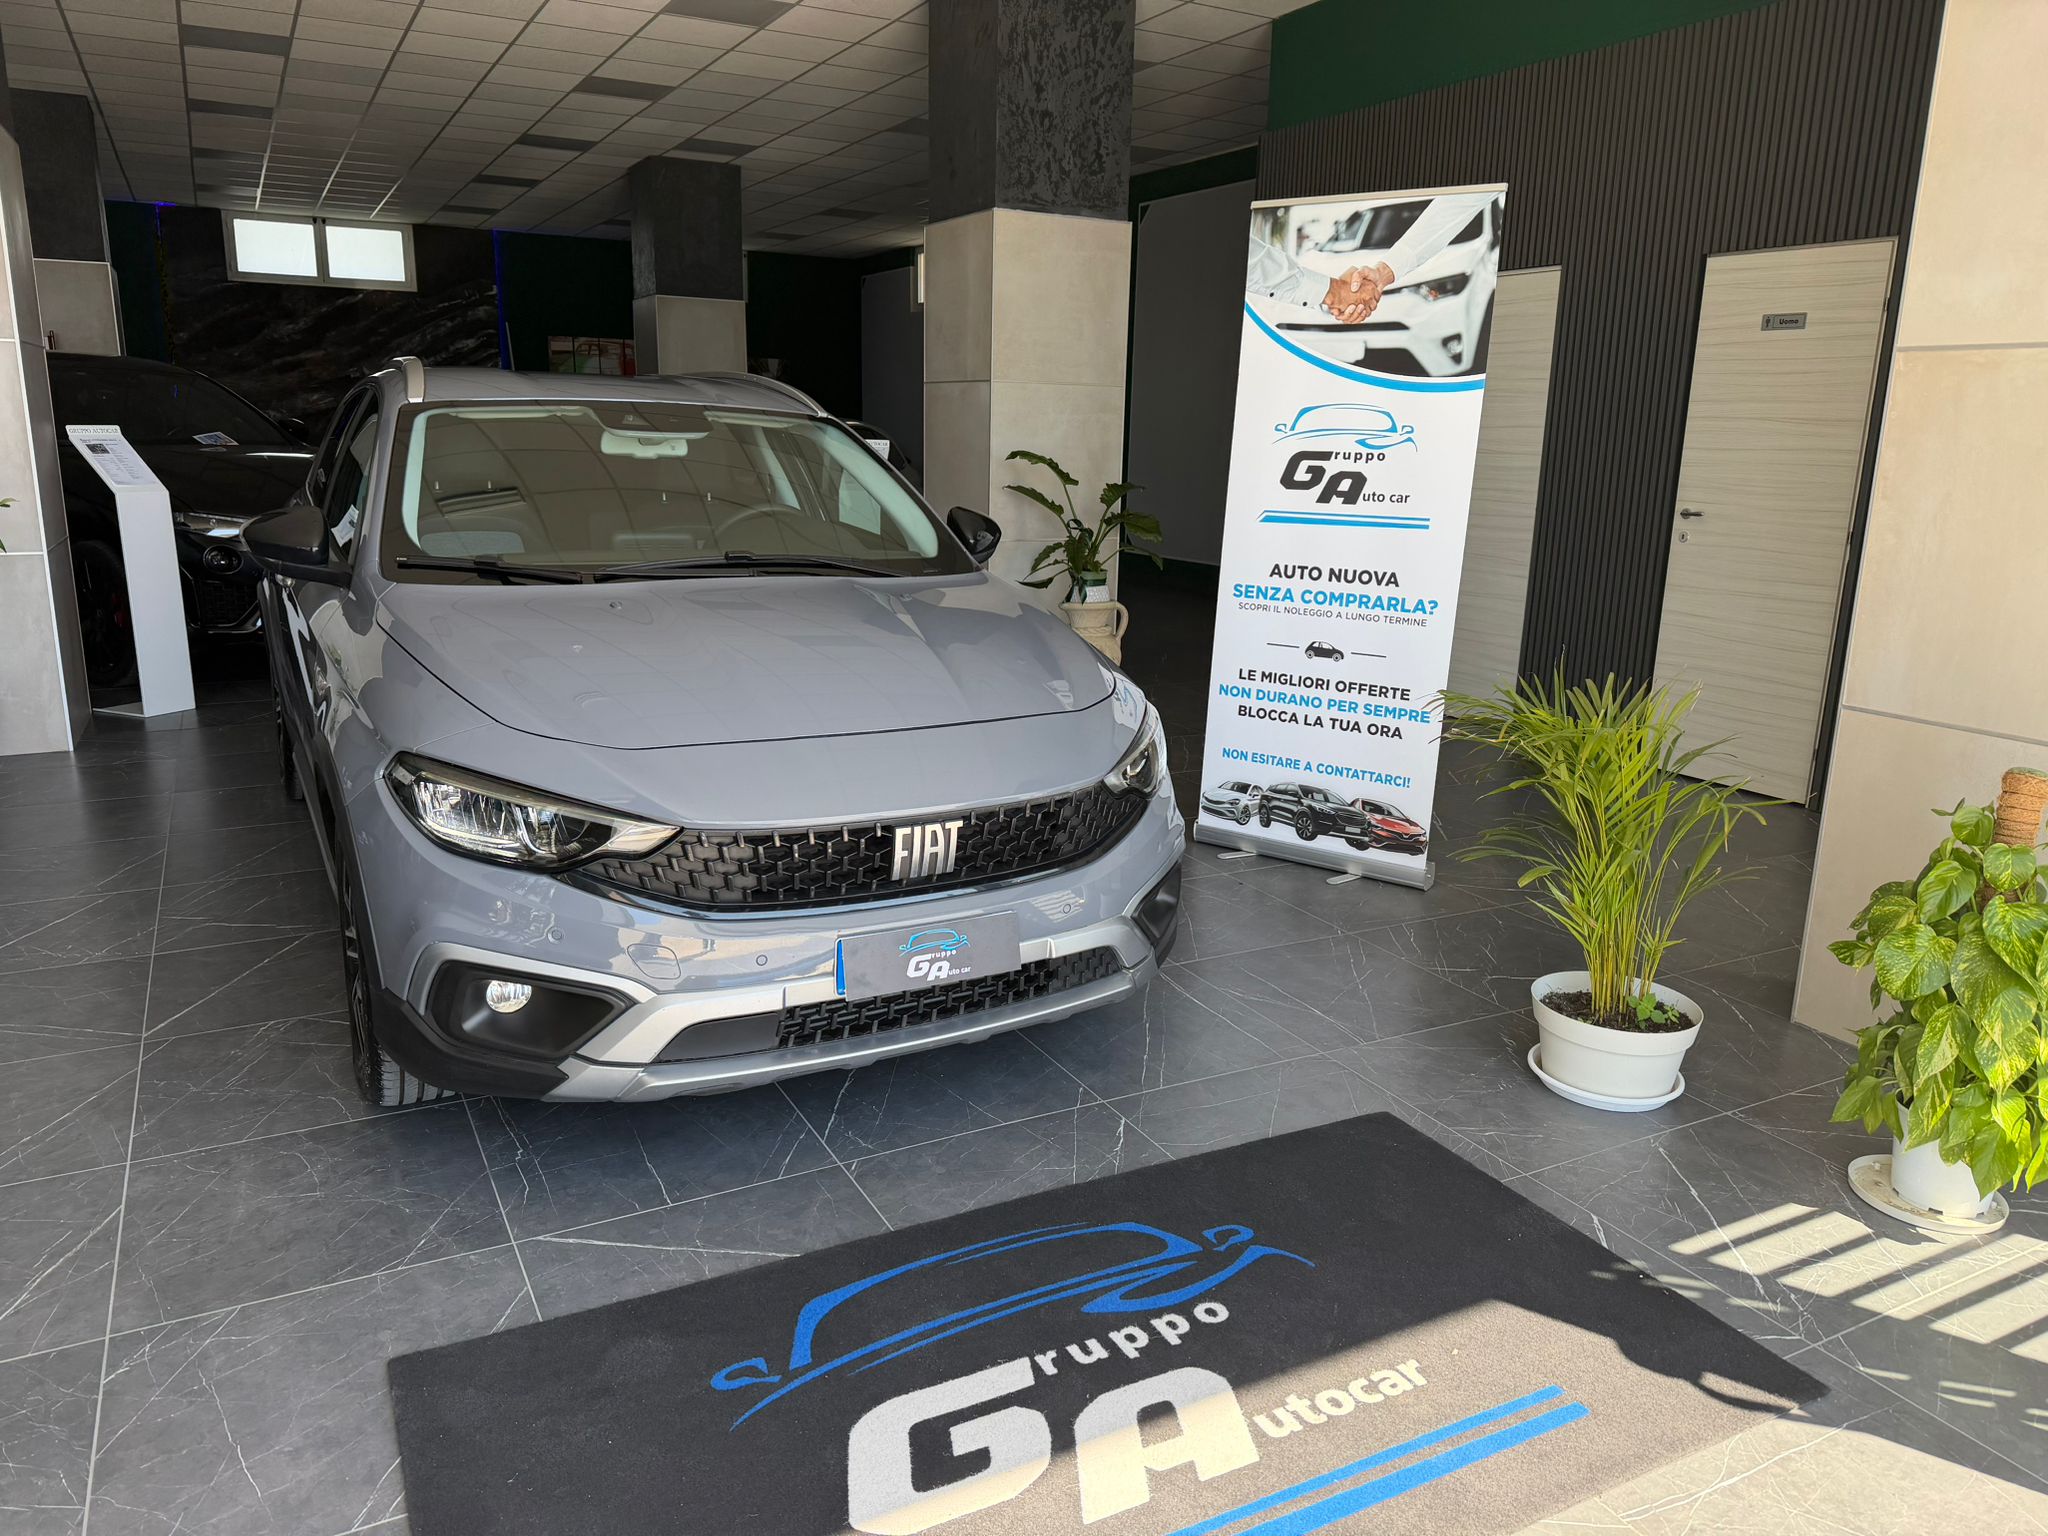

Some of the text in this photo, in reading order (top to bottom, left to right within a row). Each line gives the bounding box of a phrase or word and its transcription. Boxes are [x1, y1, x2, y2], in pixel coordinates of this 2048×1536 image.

[1389, 494, 1411, 504] car
[1269, 563, 1400, 588] AUTO NUOVA
[1233, 583, 1439, 615] SENZA COMPRARLA?
[1238, 601, 1428, 627] SCOPRI IL NOLEGGIO A LUNGO TERMINE
[1238, 668, 1411, 701] LE MIGLIORI OFFERTE
[1218, 683, 1431, 724] NON DURANO PER SEMPRE
[1238, 705, 1404, 740] BLOCCA LA TUA ORA
[1222, 747, 1411, 788] NON ESITARE A CONTATTARCI!
[891, 820, 964, 881] FIAT
